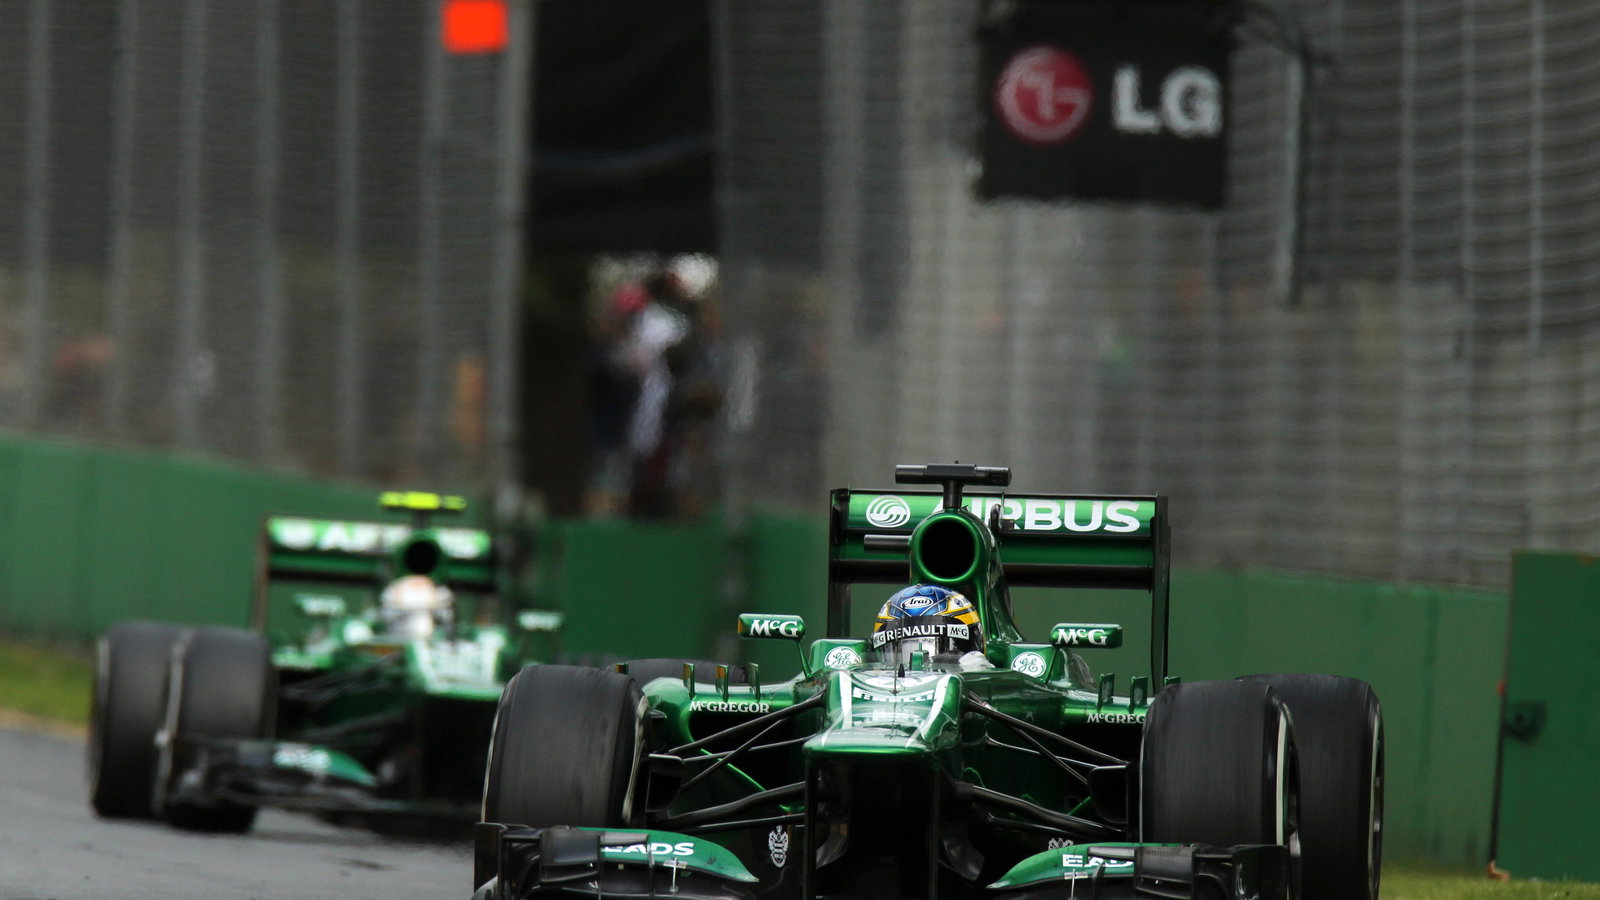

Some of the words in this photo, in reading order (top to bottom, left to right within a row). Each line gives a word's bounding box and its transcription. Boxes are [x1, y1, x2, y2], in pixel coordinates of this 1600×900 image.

[1111, 64, 1223, 138] LG
[931, 496, 1141, 532] IRBUS
[749, 619, 800, 638] McG
[886, 624, 947, 641] RENAULT
[1055, 628, 1108, 646] McG
[688, 700, 770, 714] McGREGOR
[1086, 713, 1146, 725] McGREG
